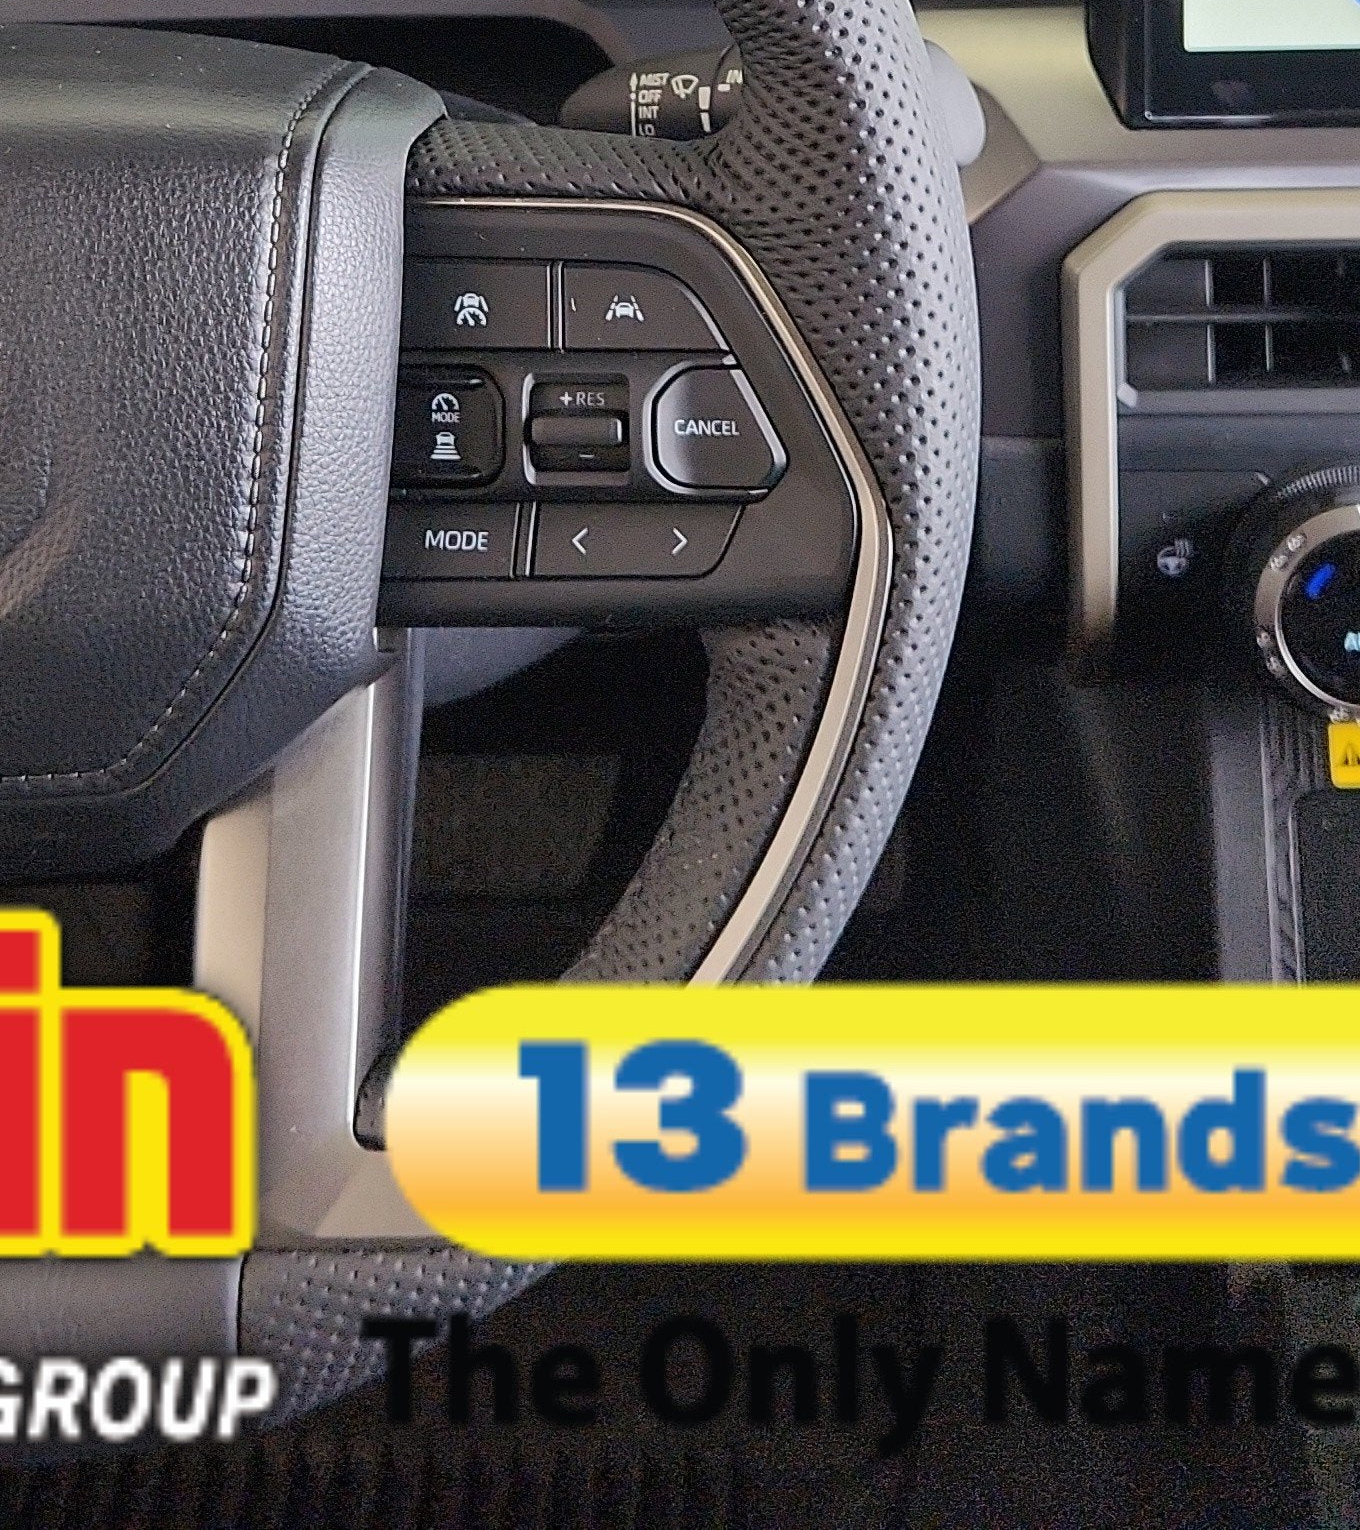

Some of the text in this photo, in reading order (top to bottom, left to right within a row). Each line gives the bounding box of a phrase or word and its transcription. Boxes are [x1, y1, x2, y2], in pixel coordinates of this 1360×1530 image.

[638, 89, 663, 104] OFF
[638, 105, 660, 119] INT
[431, 412, 461, 424] MODE
[673, 418, 740, 437] CANCEL
[424, 529, 489, 552] MODE
